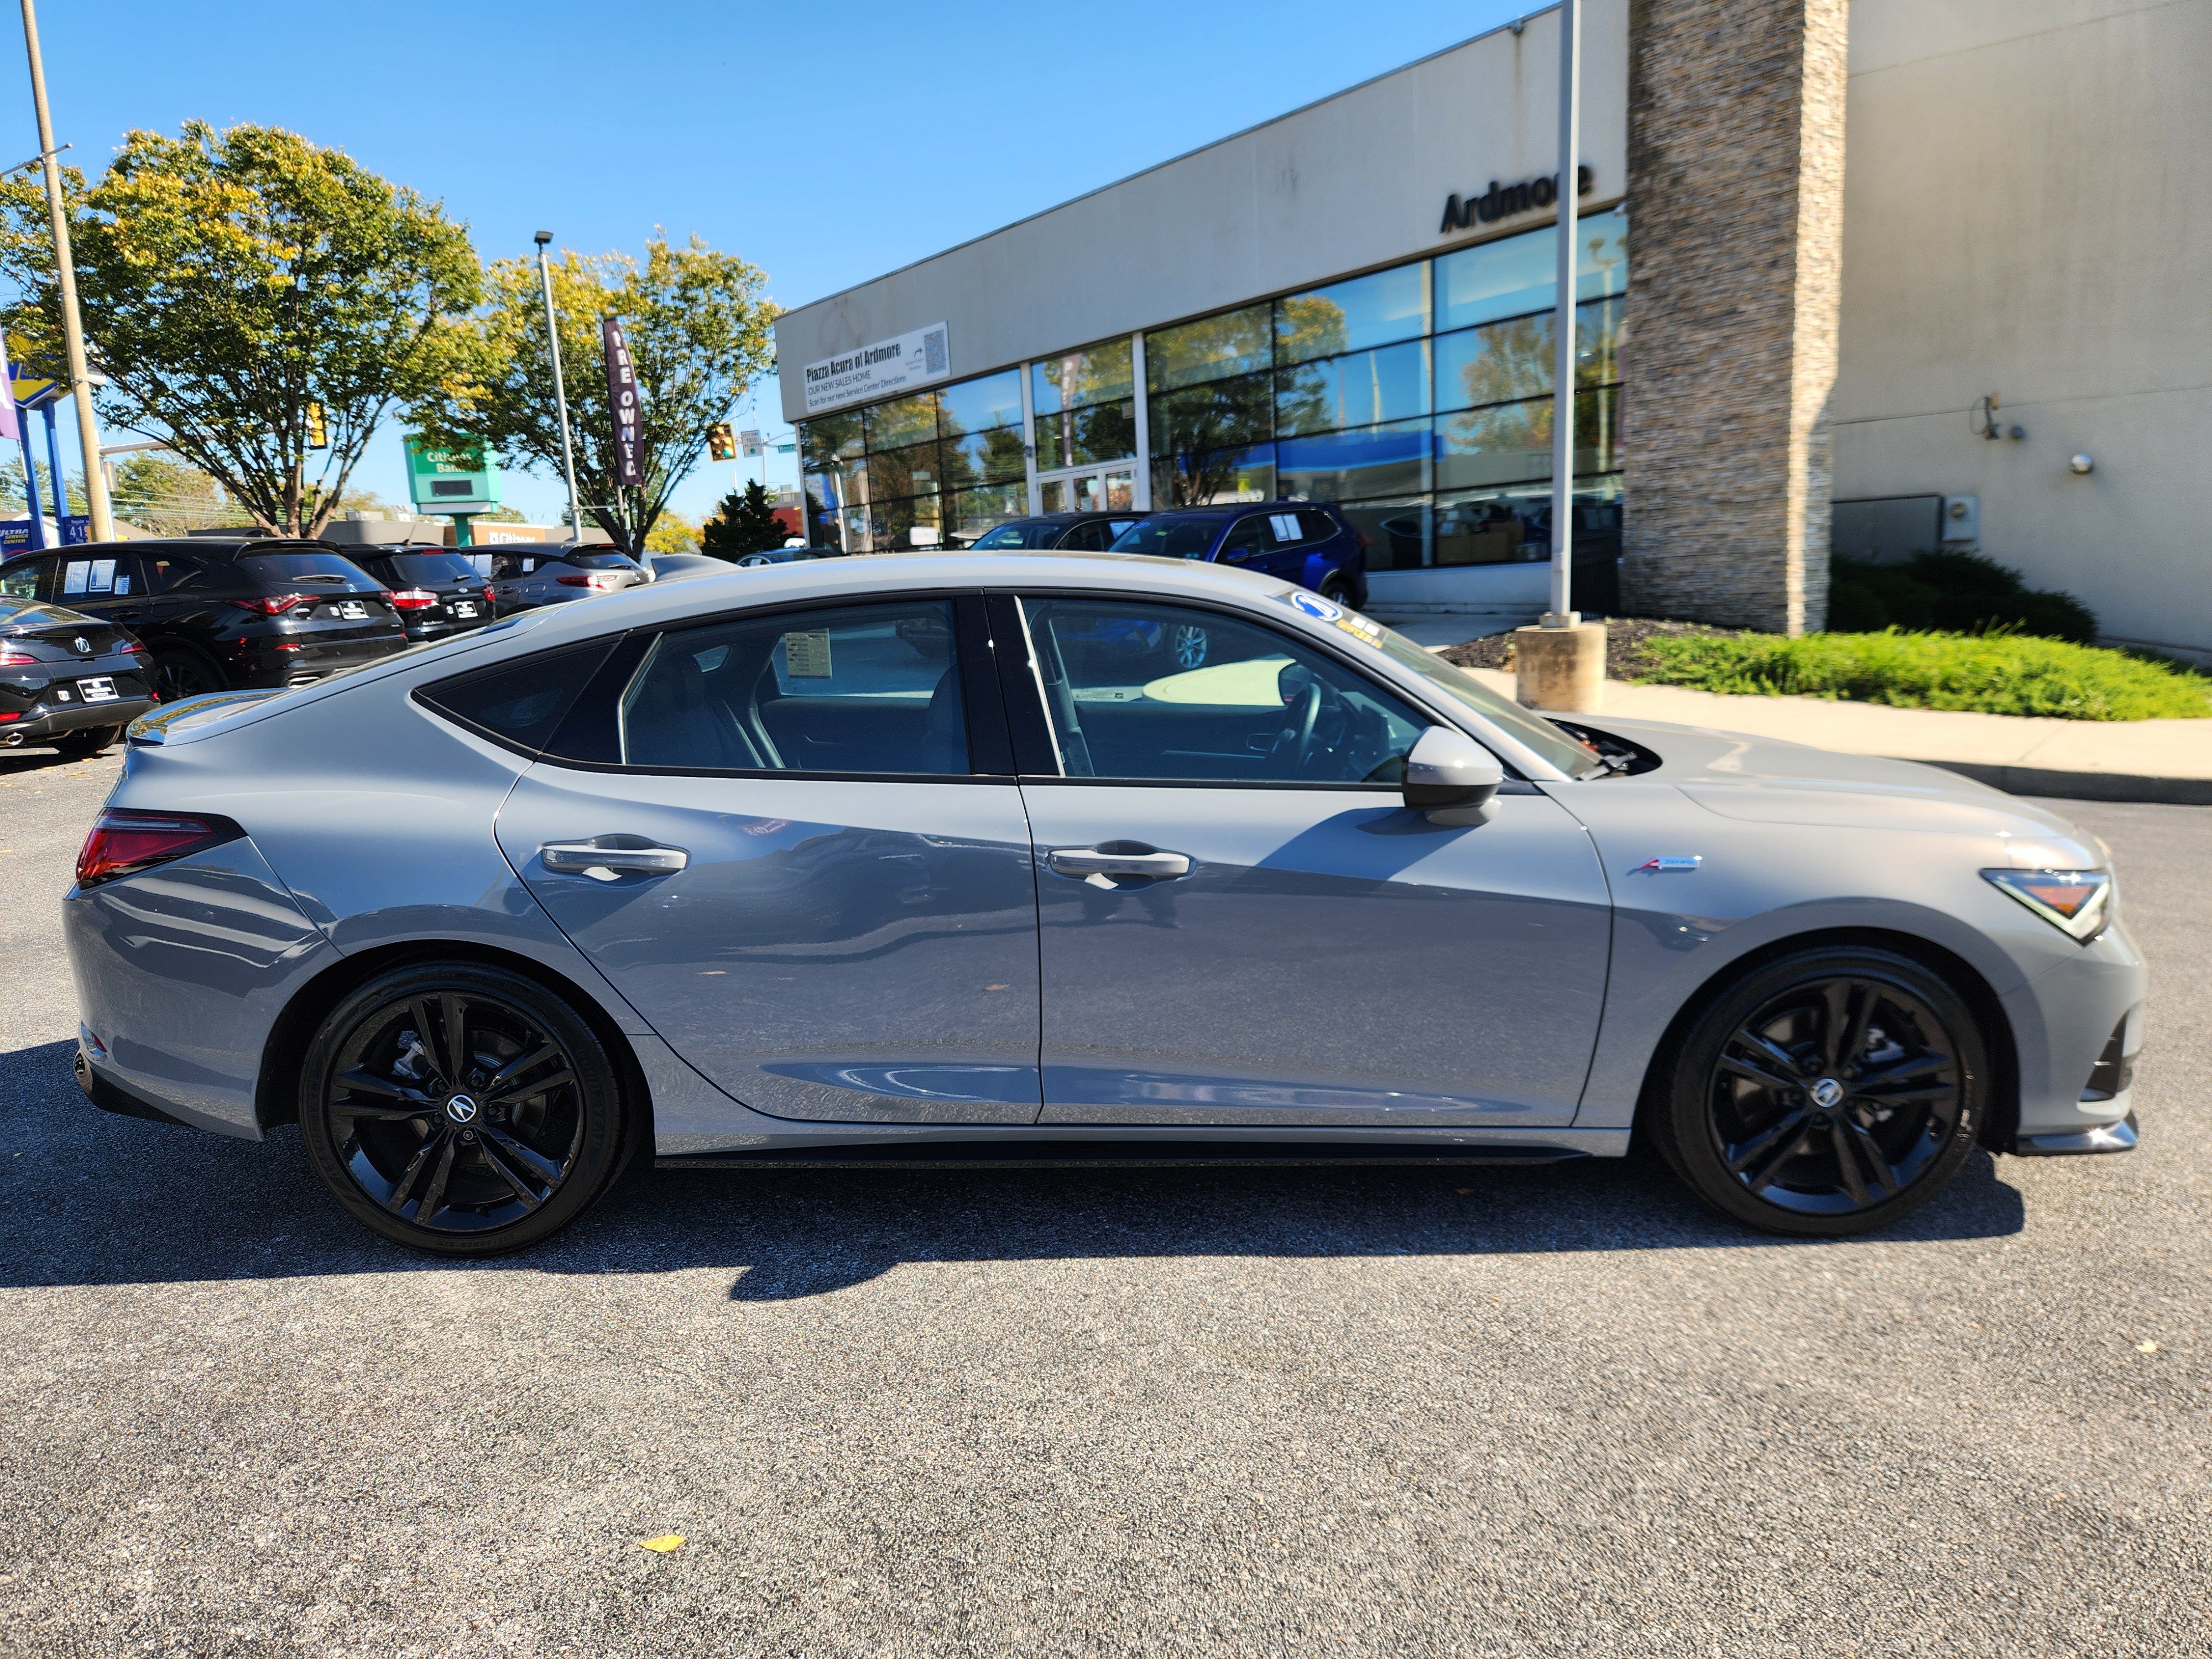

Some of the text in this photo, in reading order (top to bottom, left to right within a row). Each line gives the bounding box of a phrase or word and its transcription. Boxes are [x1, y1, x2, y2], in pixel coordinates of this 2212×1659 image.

[612, 330, 632, 384] PRE
[807, 364, 830, 383] Piazza
[831, 358, 853, 376] Acura
[855, 352, 863, 369] of
[864, 343, 901, 366] Ardmore
[808, 370, 871, 395] OUR NEW SALES HOME
[809, 398, 820, 407] Scan
[846, 387, 863, 398] Service
[864, 382, 880, 392] Center
[881, 375, 906, 388] Directions
[618, 390, 637, 476] OWNED
[0, 528, 29, 536] ULTRA
